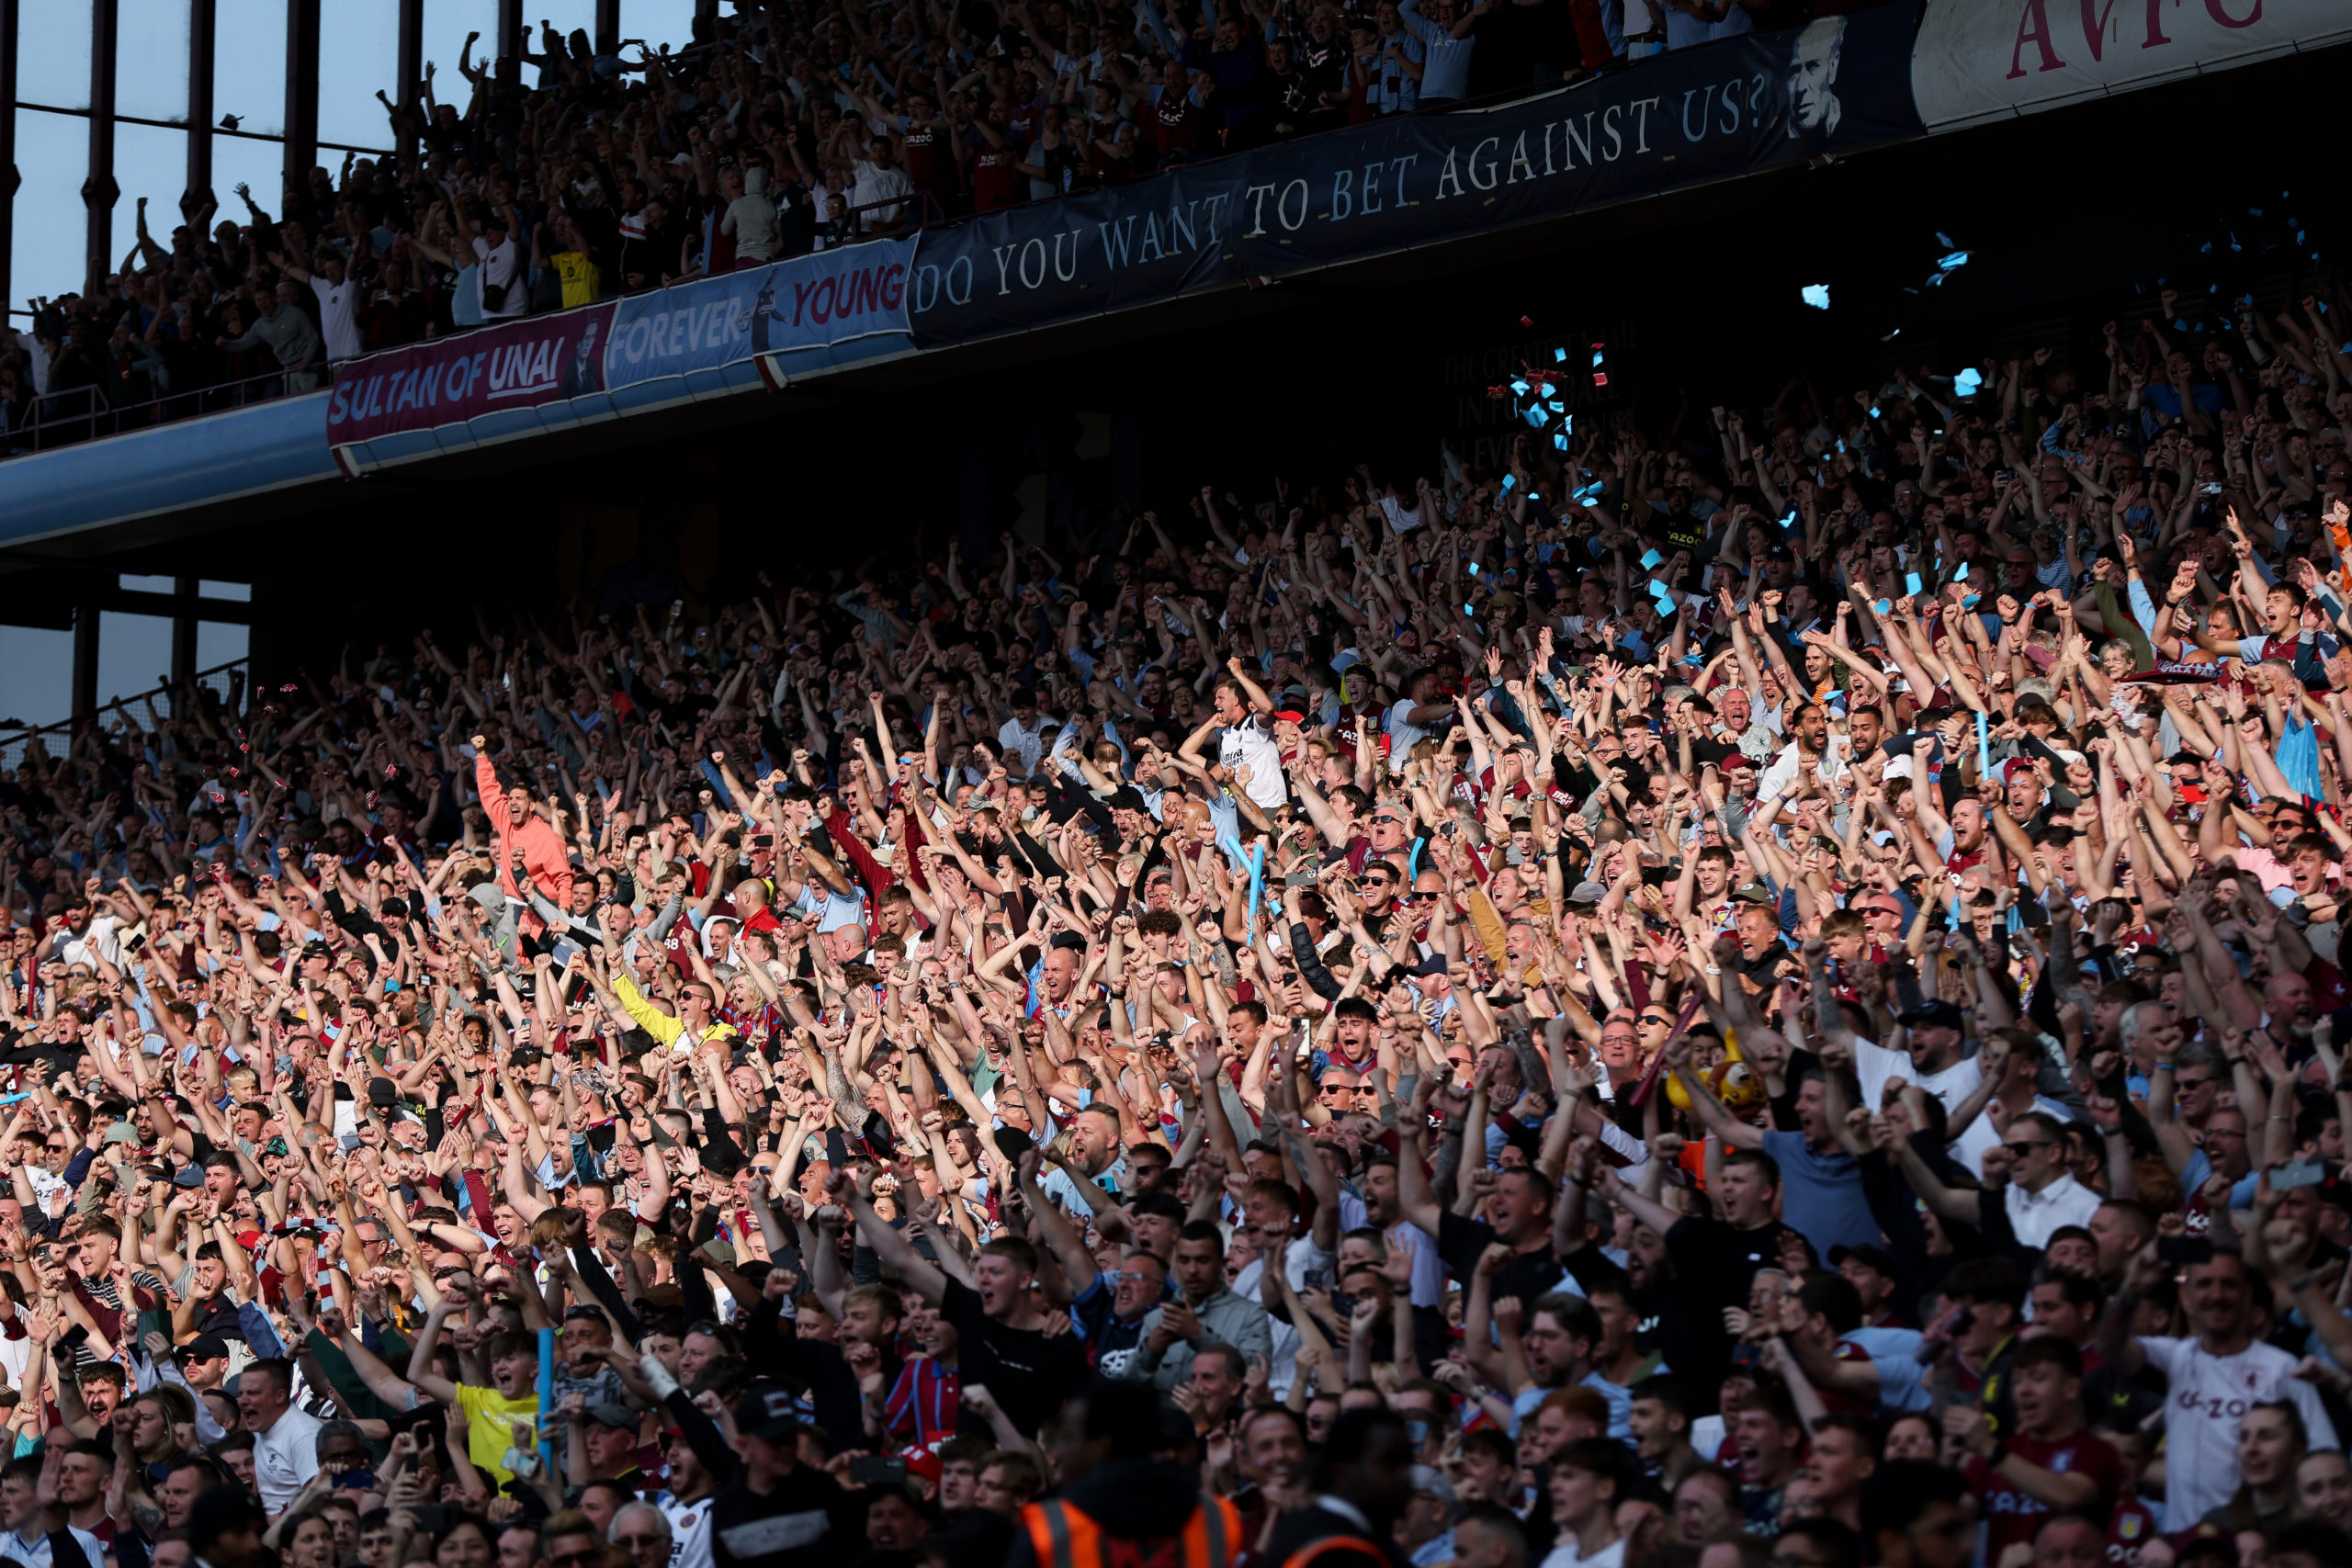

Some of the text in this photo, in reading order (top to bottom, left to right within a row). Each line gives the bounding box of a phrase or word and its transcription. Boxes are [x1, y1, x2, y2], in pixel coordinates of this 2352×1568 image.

[914, 73, 1765, 313] DO YOU WANT TO BET AGAINST US?
[609, 263, 905, 369] FOREVER YOUNG
[329, 337, 564, 425] SULTAN OF UNAI
